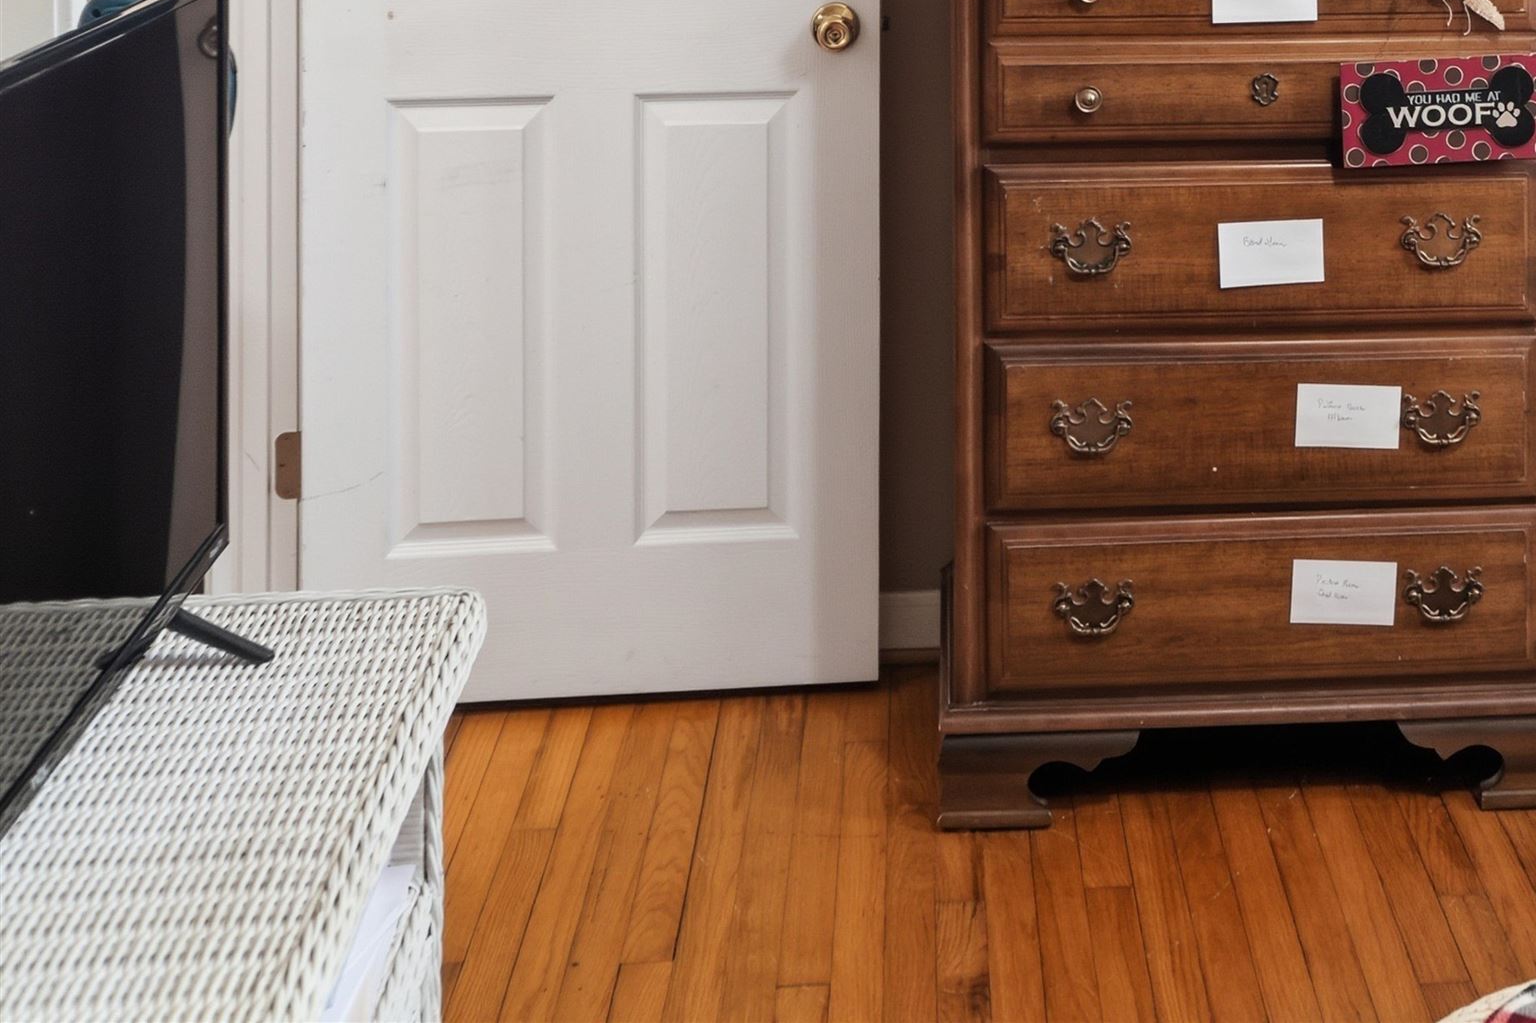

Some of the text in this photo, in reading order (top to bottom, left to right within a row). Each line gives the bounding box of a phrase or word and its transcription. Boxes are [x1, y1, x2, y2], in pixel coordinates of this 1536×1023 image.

[1406, 90, 1501, 106] YOU HAD ME AT
[1386, 102, 1495, 129] WOOF
